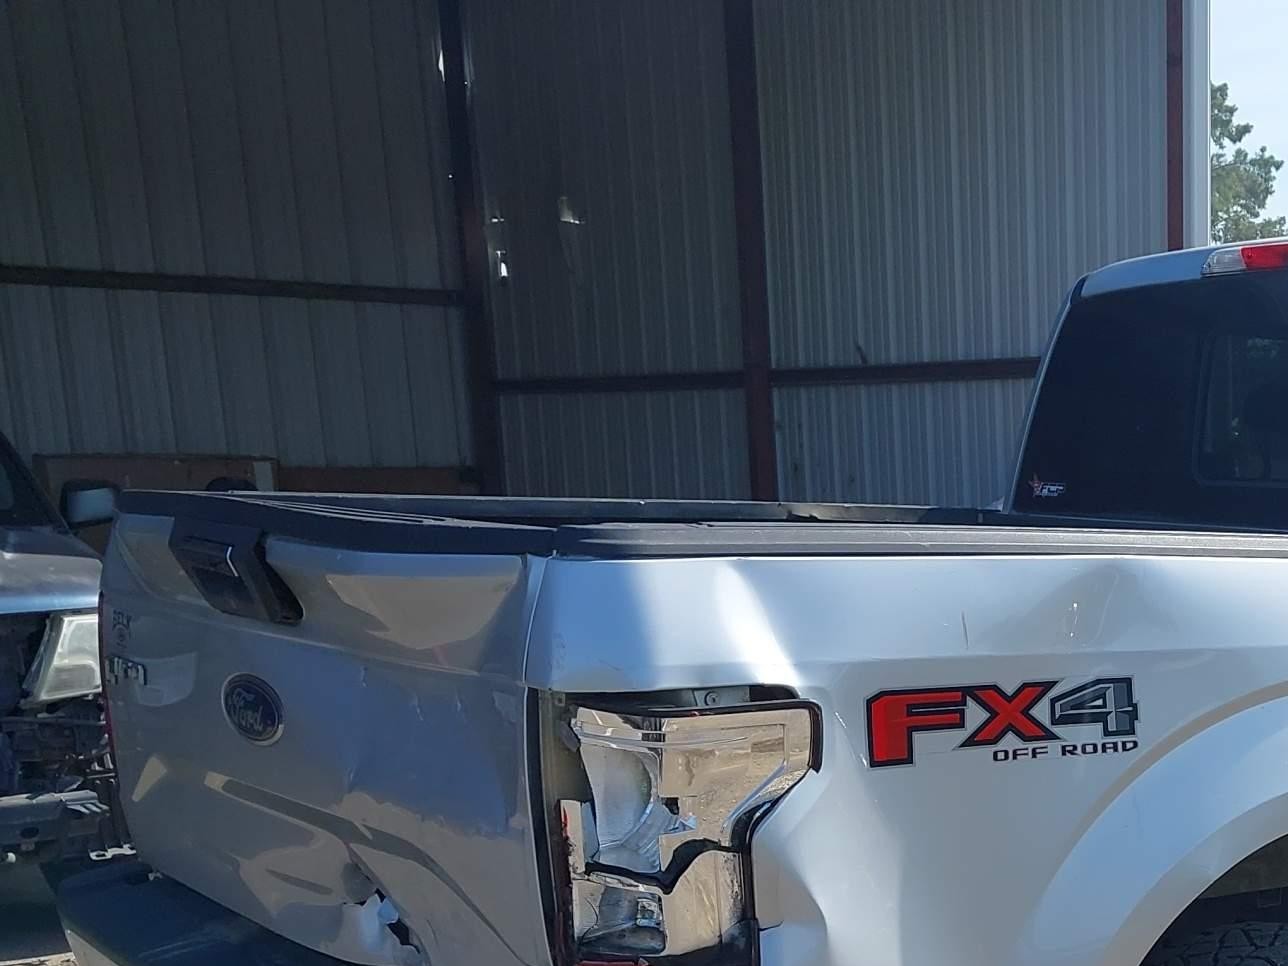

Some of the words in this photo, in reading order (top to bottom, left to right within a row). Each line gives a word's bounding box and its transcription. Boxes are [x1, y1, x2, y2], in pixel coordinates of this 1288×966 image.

[866, 676, 1139, 768] FX4
[992, 746, 1049, 763] OFF
[1061, 740, 1139, 757] ROAD
